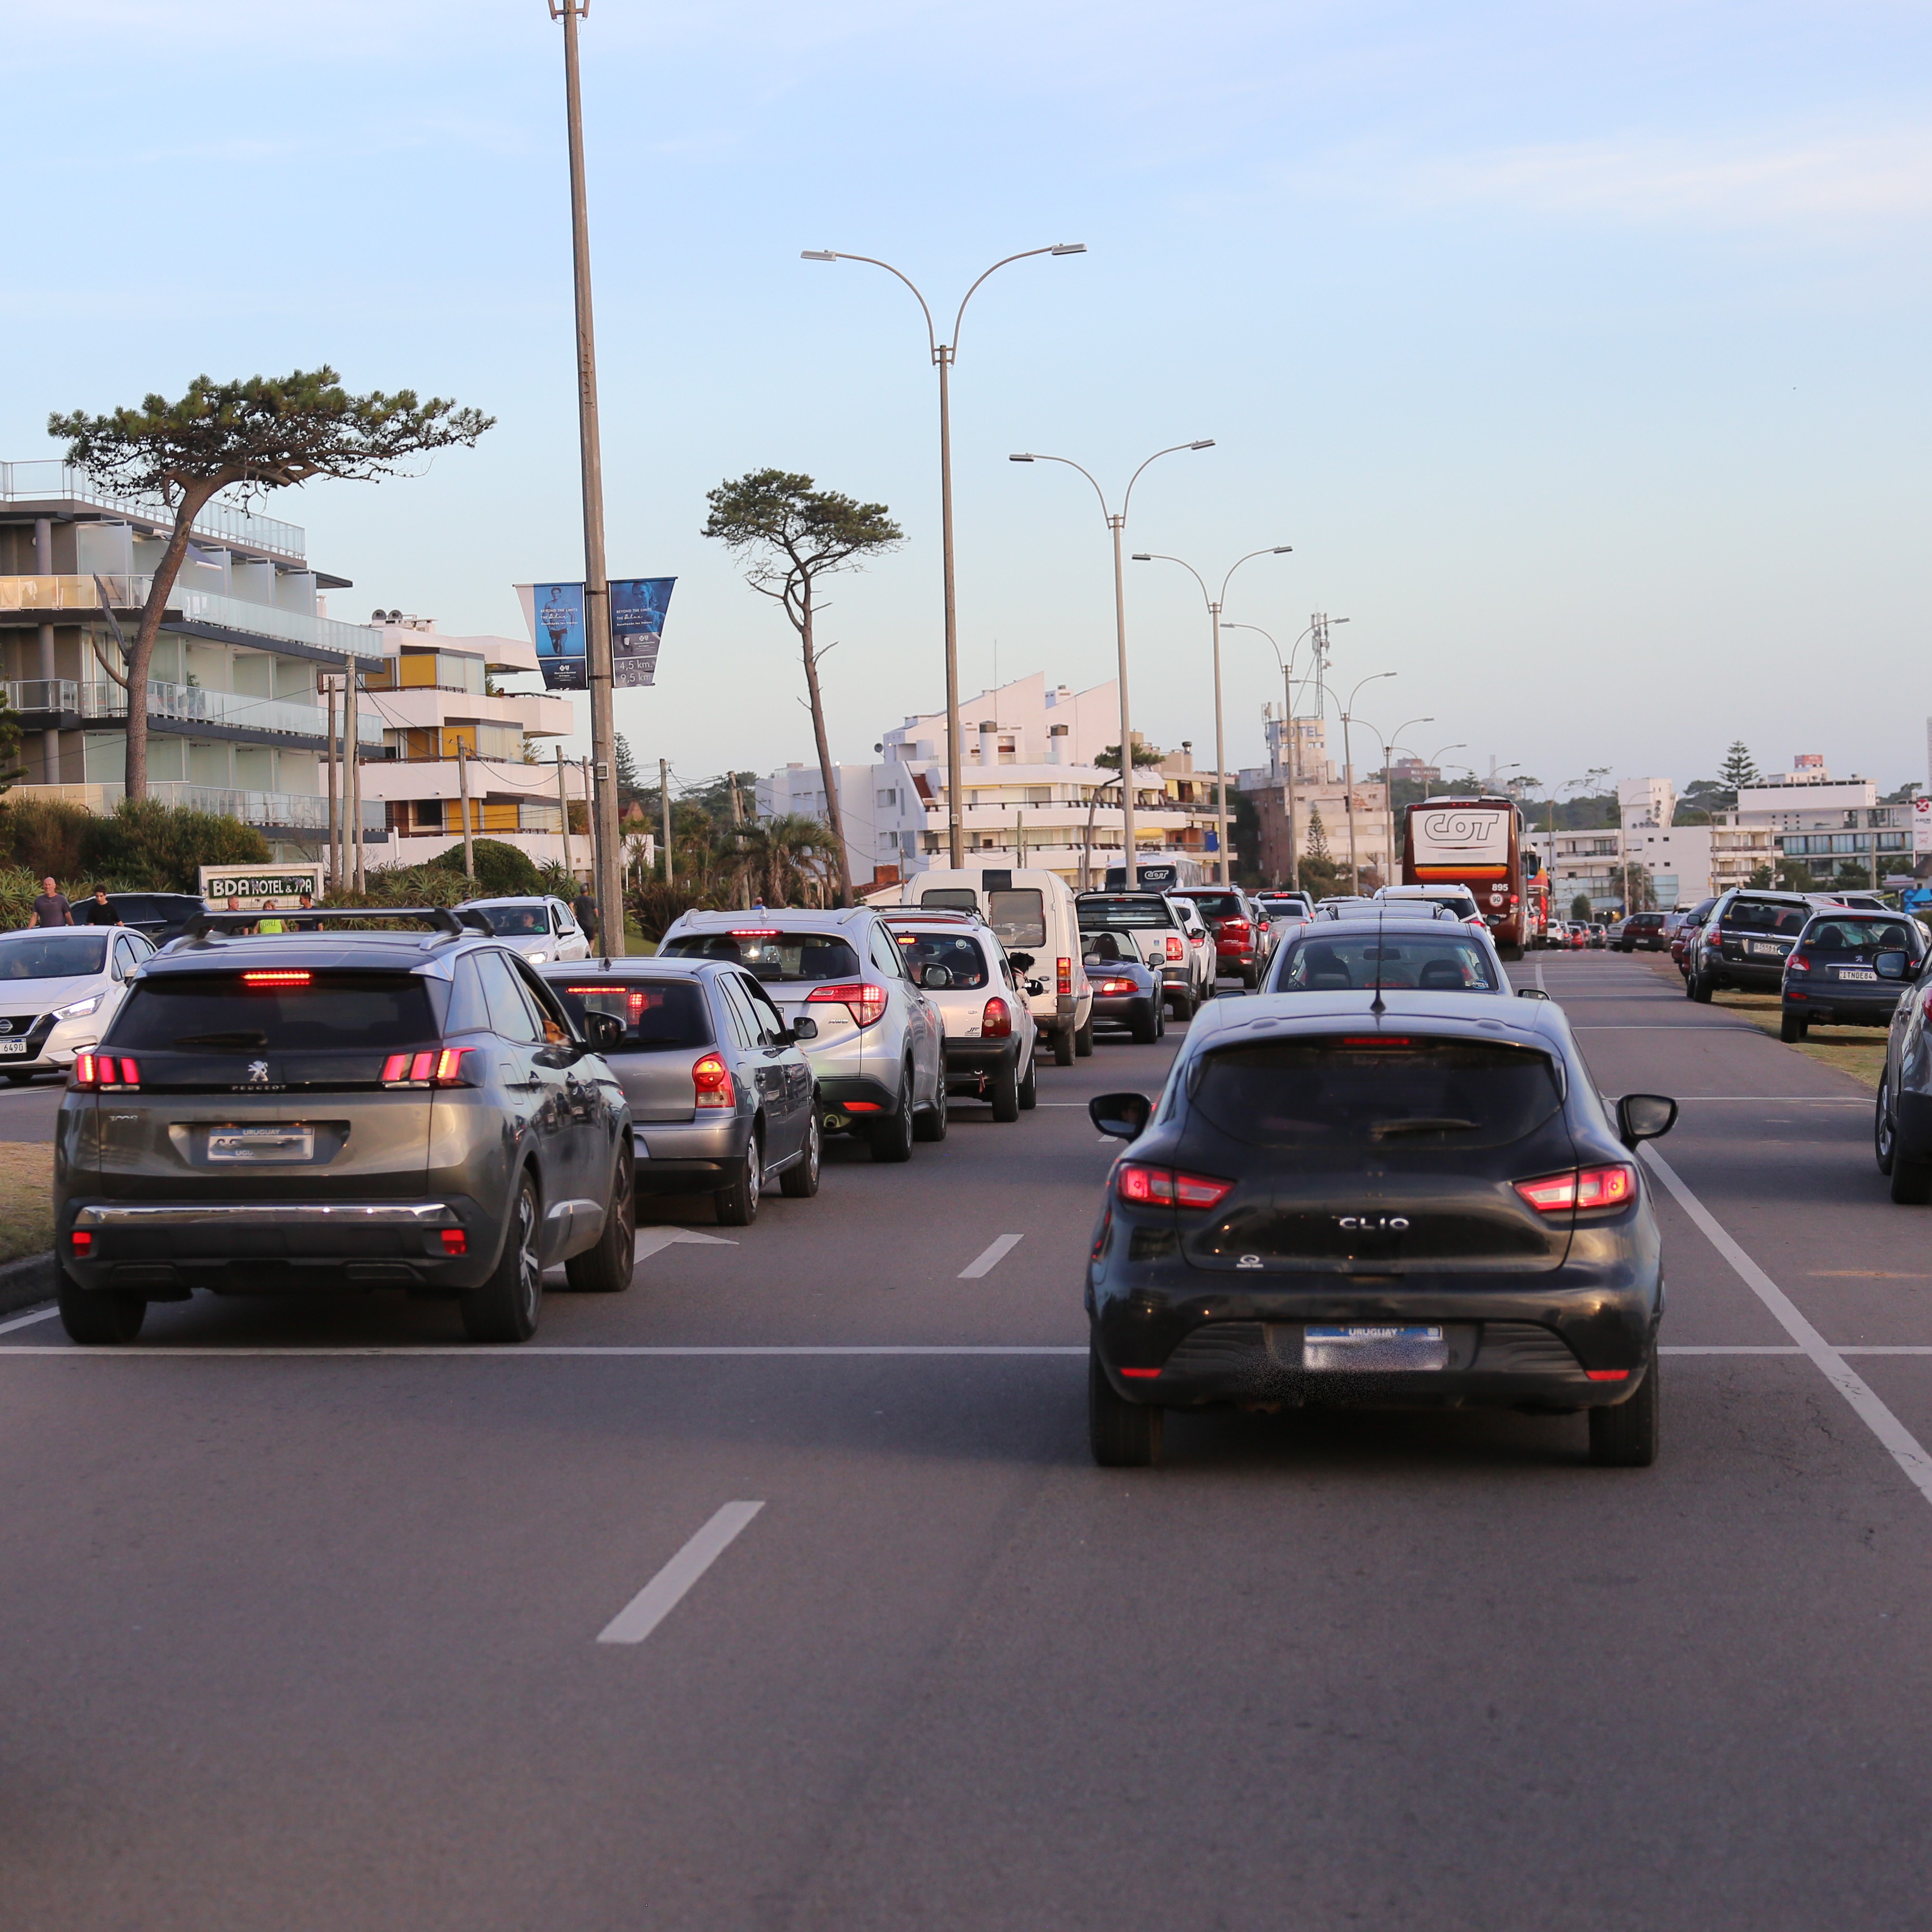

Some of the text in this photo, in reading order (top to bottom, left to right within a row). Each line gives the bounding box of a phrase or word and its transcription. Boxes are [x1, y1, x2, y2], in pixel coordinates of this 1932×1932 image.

[620, 660, 652, 670] 4,5 km.
[620, 672, 651, 683] 9,5 km
[1425, 813, 1499, 840] COT
[1144, 870, 1169, 880] COT
[213, 879, 249, 896] BDA
[4, 1043, 23, 1052] 6490
[1339, 1218, 1409, 1229] CLIO
